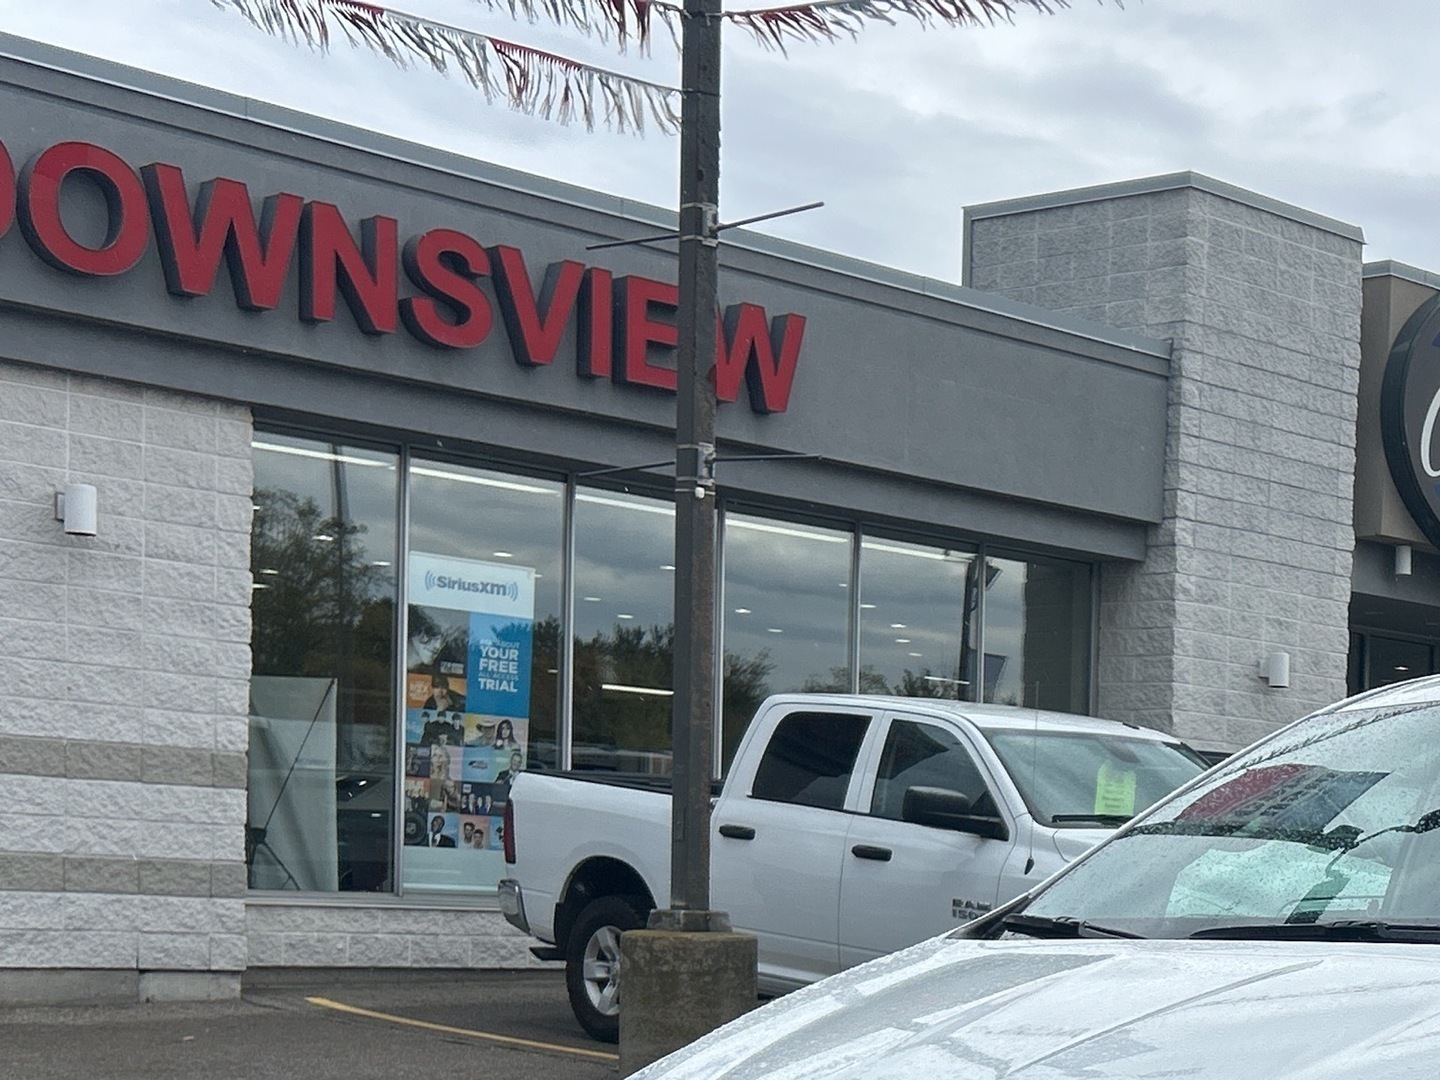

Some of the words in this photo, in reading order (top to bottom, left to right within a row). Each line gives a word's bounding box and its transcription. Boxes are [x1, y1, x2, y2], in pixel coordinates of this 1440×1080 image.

[0, 139, 806, 413] OWNSVIEW
[480, 645, 519, 661] YOUR
[479, 658, 519, 674] FREE
[478, 677, 518, 692] TRIAL
